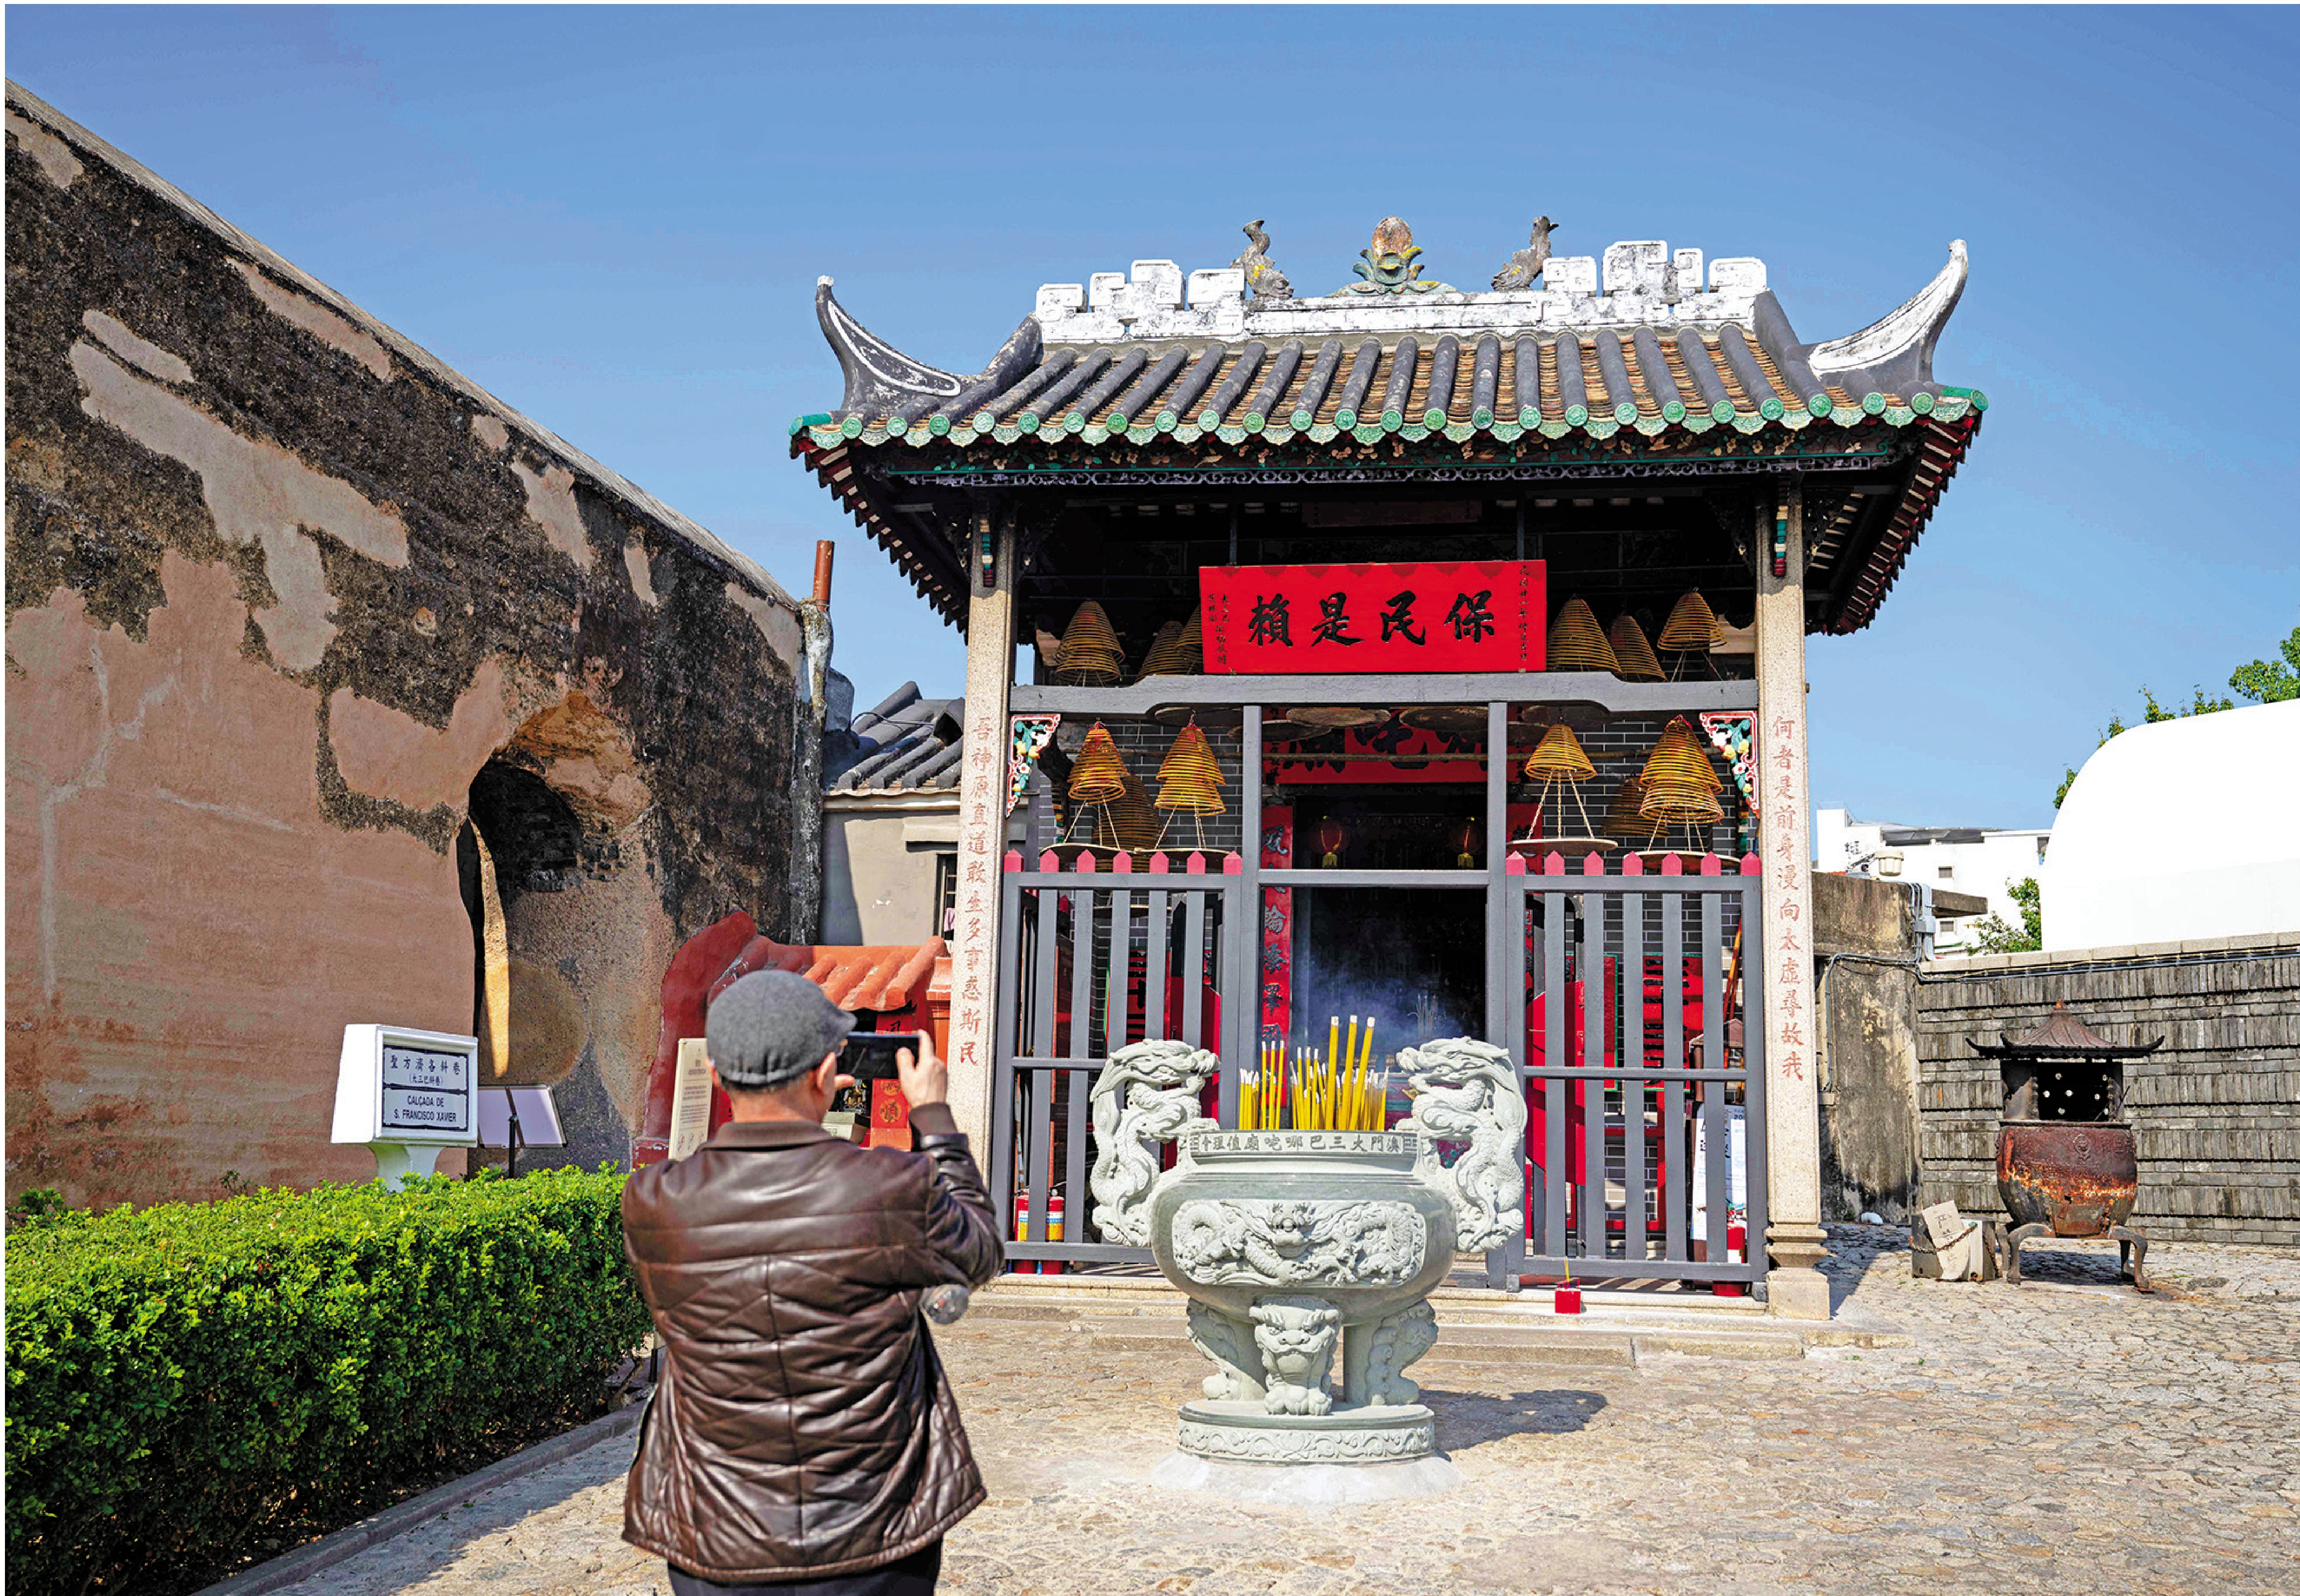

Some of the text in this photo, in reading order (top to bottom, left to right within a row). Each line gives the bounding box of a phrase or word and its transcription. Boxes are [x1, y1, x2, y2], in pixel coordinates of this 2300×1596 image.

[407, 1095, 444, 1107] CALÇADA DE
[394, 1108, 457, 1122] S. FRANCISCO XAVIER
